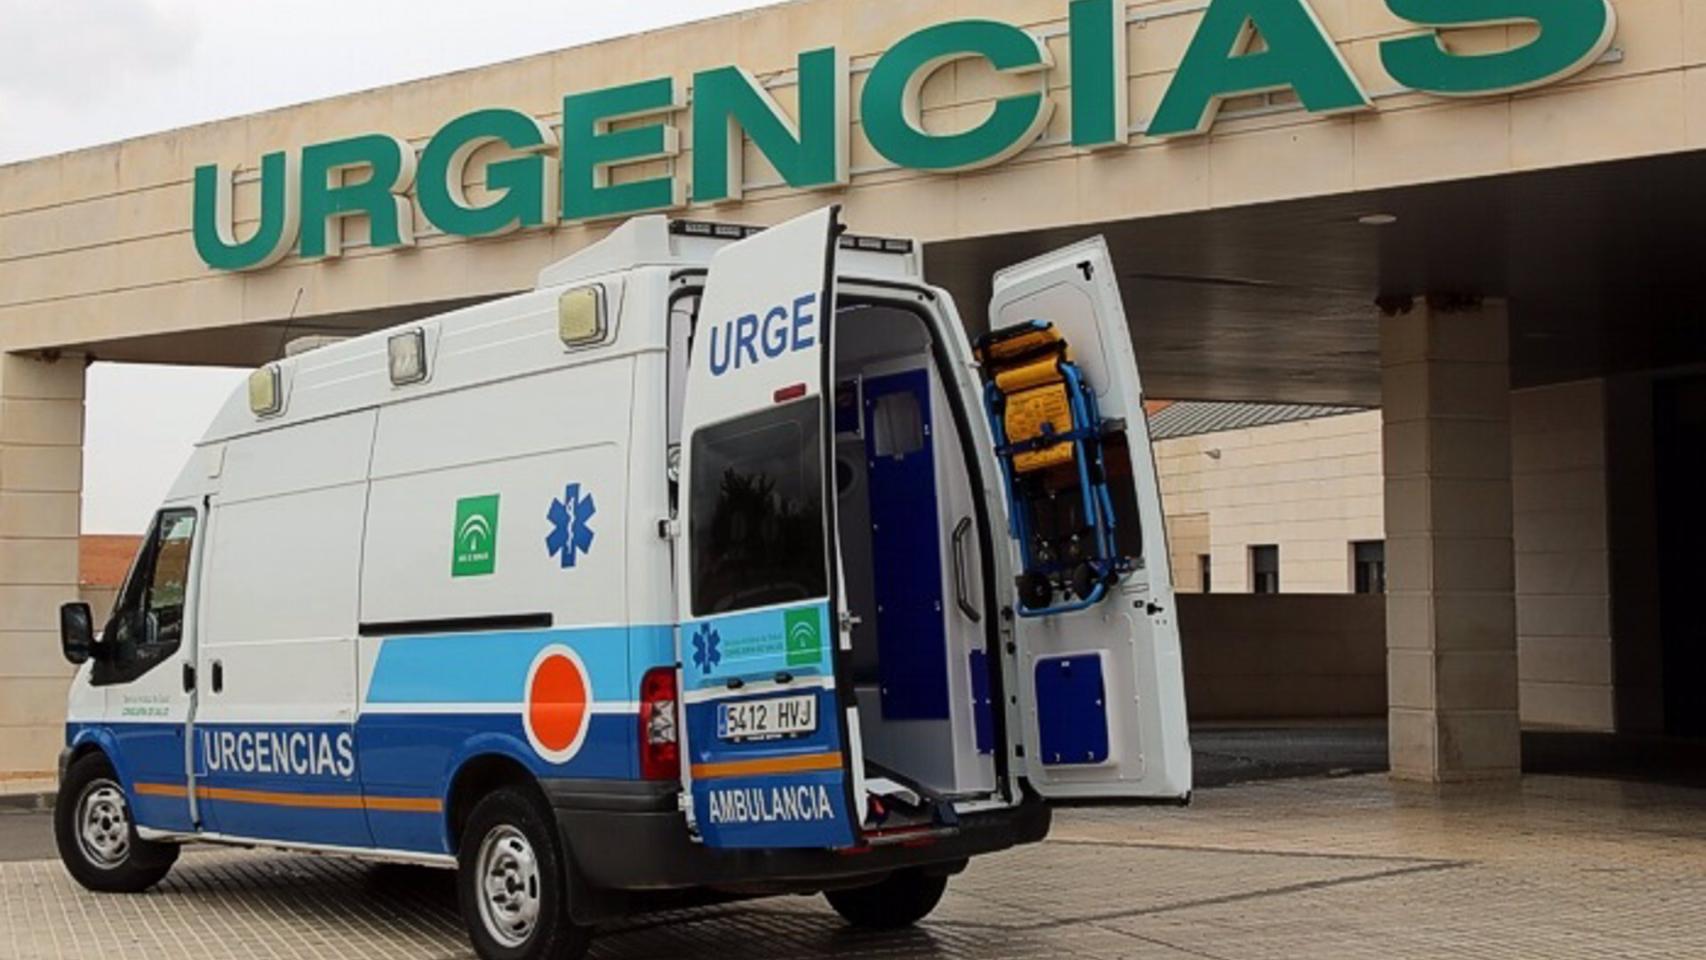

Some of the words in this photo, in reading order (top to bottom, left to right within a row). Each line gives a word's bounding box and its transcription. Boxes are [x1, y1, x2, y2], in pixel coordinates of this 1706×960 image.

[192, 0, 1614, 270] URGENCIAS
[709, 292, 816, 376] URGE
[727, 704, 767, 732] 5412
[778, 699, 811, 728] HVJ
[204, 731, 355, 776] URGENCIAS
[709, 784, 835, 823] AMBULANCIA
